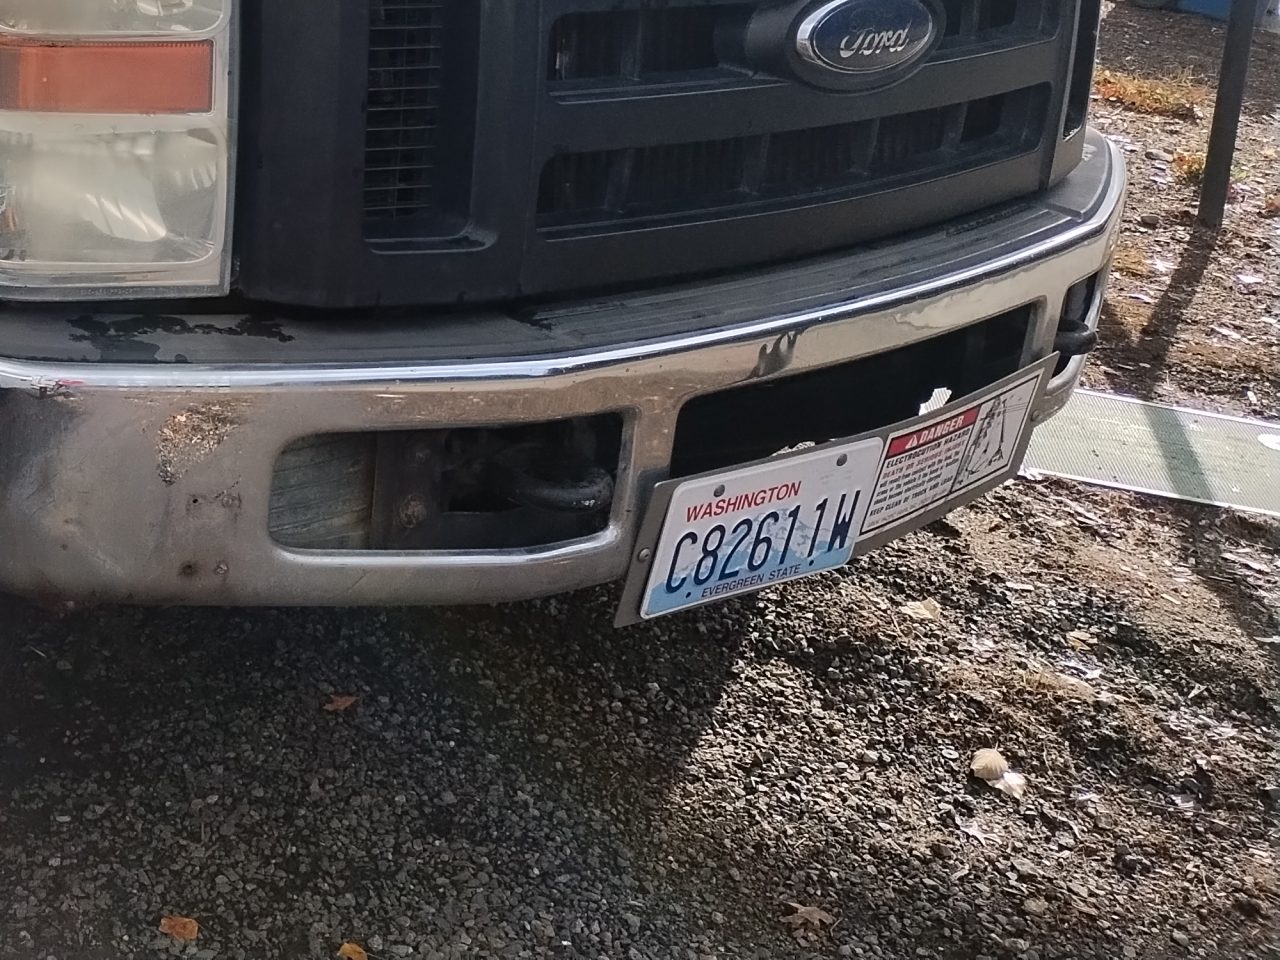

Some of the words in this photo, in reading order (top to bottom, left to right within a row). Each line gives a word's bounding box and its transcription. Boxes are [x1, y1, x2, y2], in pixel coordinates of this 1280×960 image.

[839, 8, 913, 59] Ford
[919, 415, 964, 443] DANGER
[886, 441, 942, 469] ELECTROCUTION
[685, 480, 802, 523] WASHINGTON
[665, 490, 862, 594] C82611W
[701, 574, 765, 598] EVERGREEN
[768, 563, 802, 580] STATE
